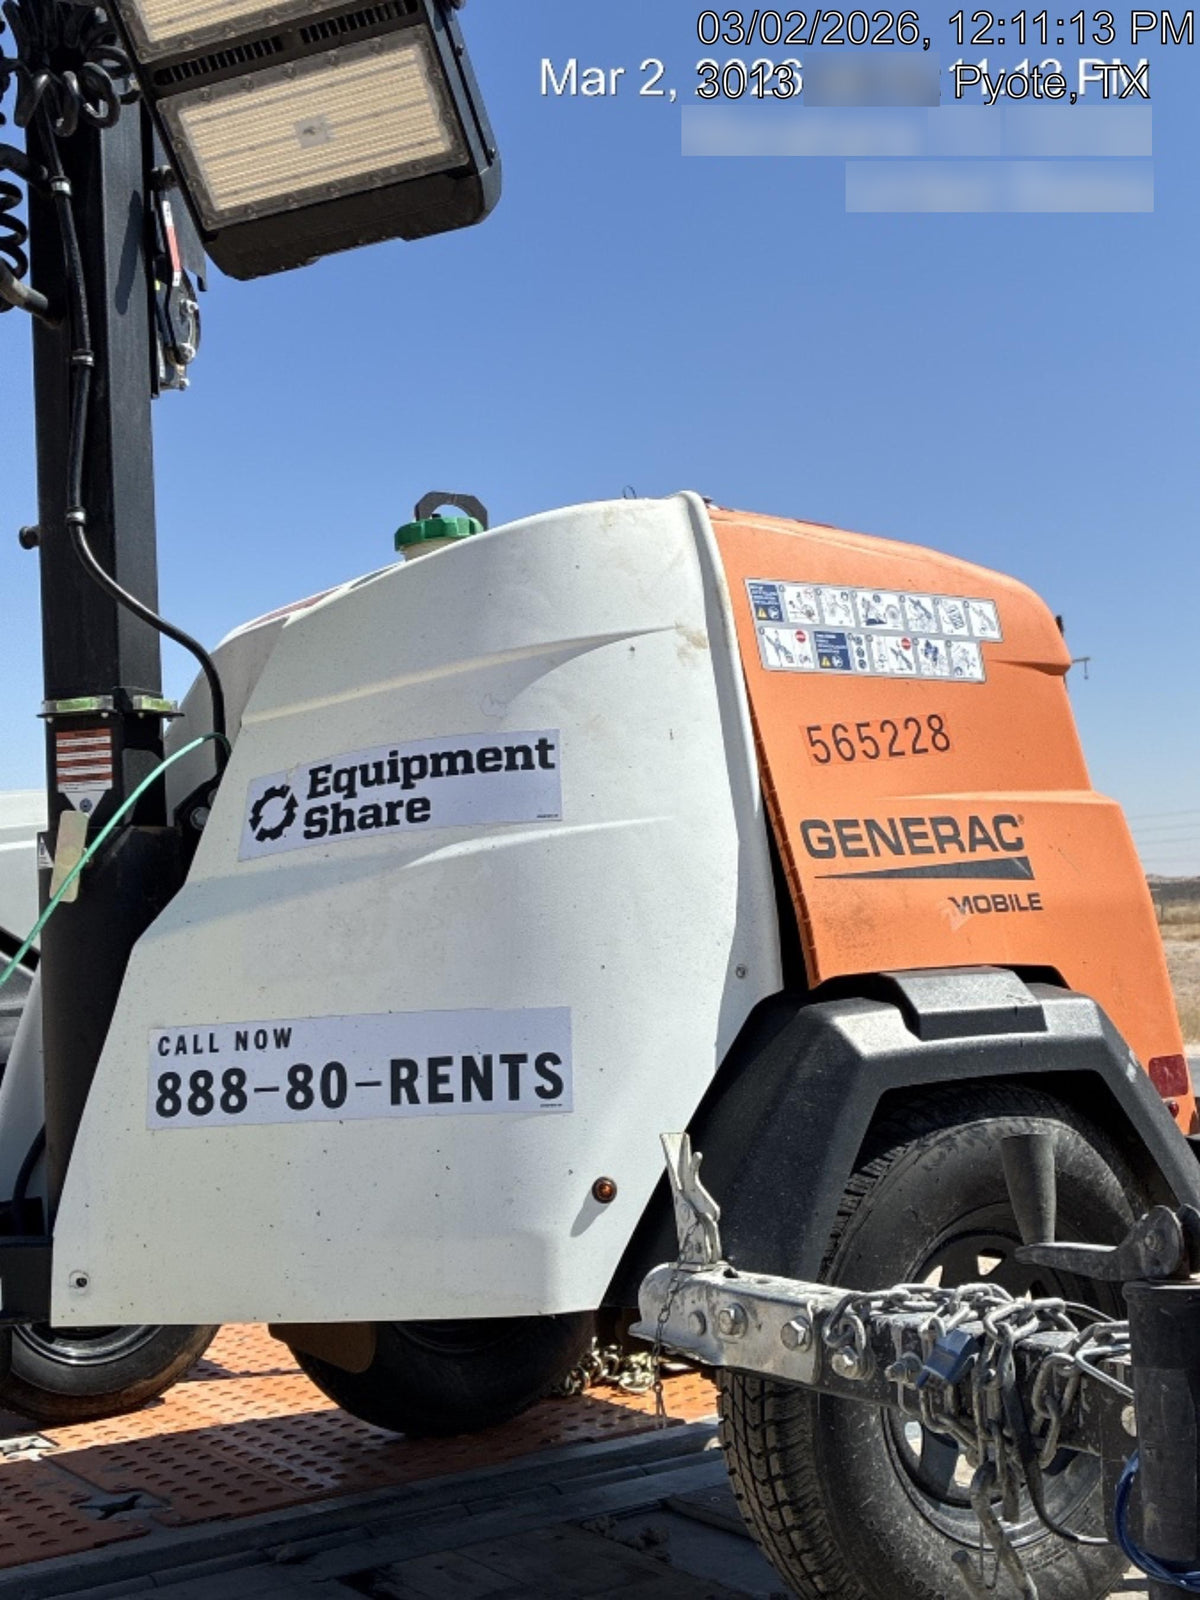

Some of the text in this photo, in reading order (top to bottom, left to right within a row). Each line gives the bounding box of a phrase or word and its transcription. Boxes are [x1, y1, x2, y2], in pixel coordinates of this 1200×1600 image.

[806, 713, 950, 764] 565228
[306, 737, 556, 800] Equipment
[303, 796, 431, 840] Share
[800, 814, 1025, 859] GENERAC
[947, 892, 1044, 915] MOBILE
[158, 1027, 293, 1056] CALL NOW
[155, 1051, 565, 1118] 888-80-RENTS
